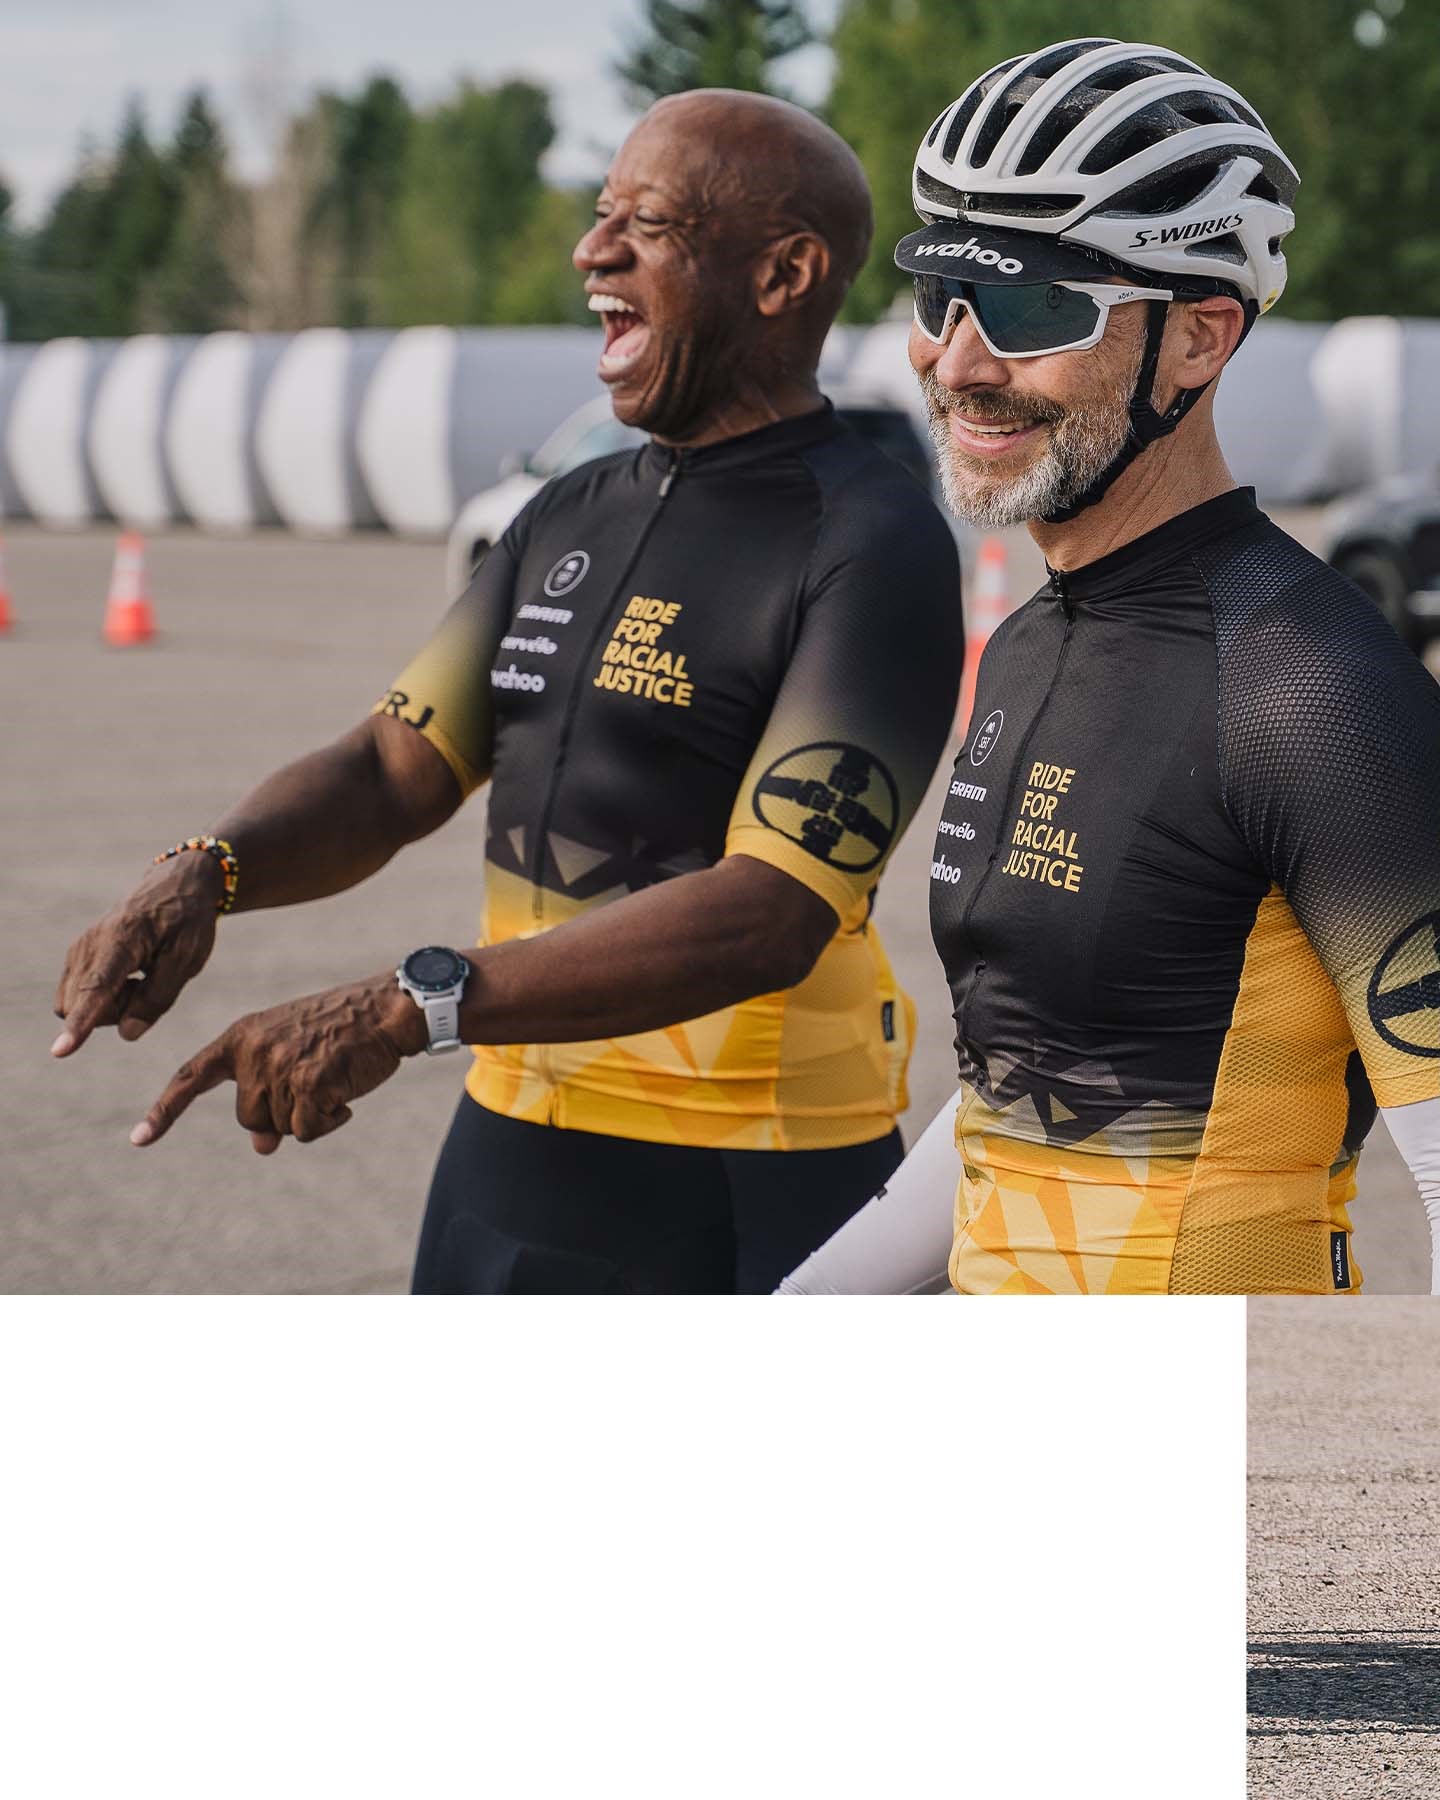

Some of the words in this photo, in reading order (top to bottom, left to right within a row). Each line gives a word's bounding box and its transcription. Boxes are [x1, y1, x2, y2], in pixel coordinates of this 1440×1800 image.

[1128, 214, 1243, 248] S-WORKS
[914, 237, 1024, 275] wahoo
[625, 595, 682, 625] RIDE
[613, 618, 663, 646] FOR
[602, 640, 689, 680] RACIAL
[593, 665, 694, 708] JUSTICE
[949, 781, 987, 802] SRAM
[1028, 761, 1076, 794] RIDE
[1020, 790, 1059, 821] FOR
[1011, 819, 1079, 860] RACIAL
[1002, 849, 1084, 893] JUSTICE
